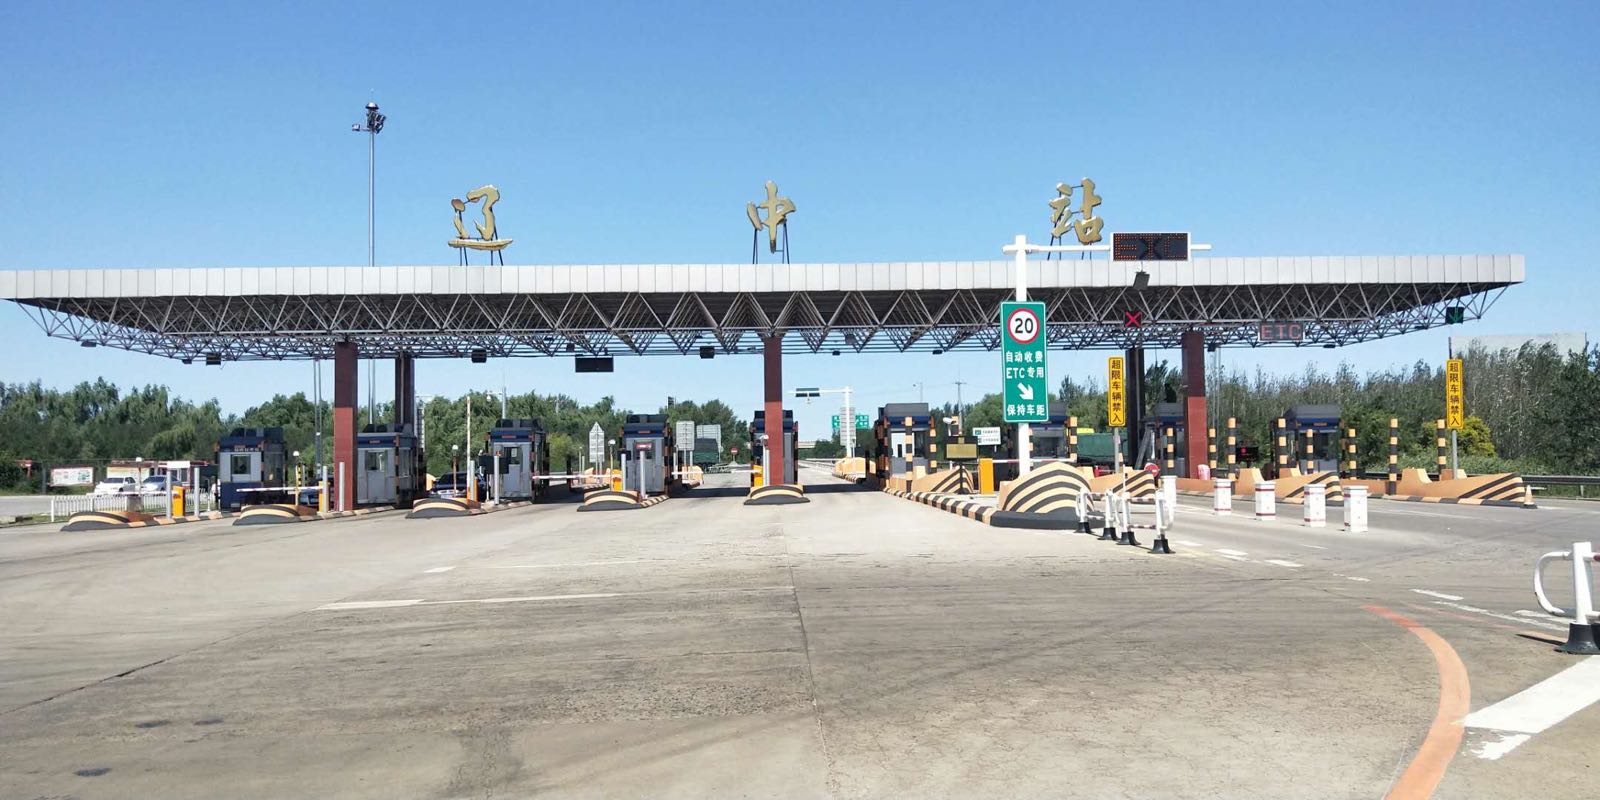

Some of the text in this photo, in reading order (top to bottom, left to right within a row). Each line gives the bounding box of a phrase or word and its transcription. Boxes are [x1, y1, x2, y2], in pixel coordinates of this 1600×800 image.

[1015, 318, 1033, 333] 20
[1261, 324, 1301, 340] ETC
[1006, 351, 1043, 362] 自动收费
[1112, 360, 1121, 422] 超限车辆禁入
[1450, 363, 1459, 425] 超限车辆禁入
[1007, 405, 1045, 416] 保持车距
